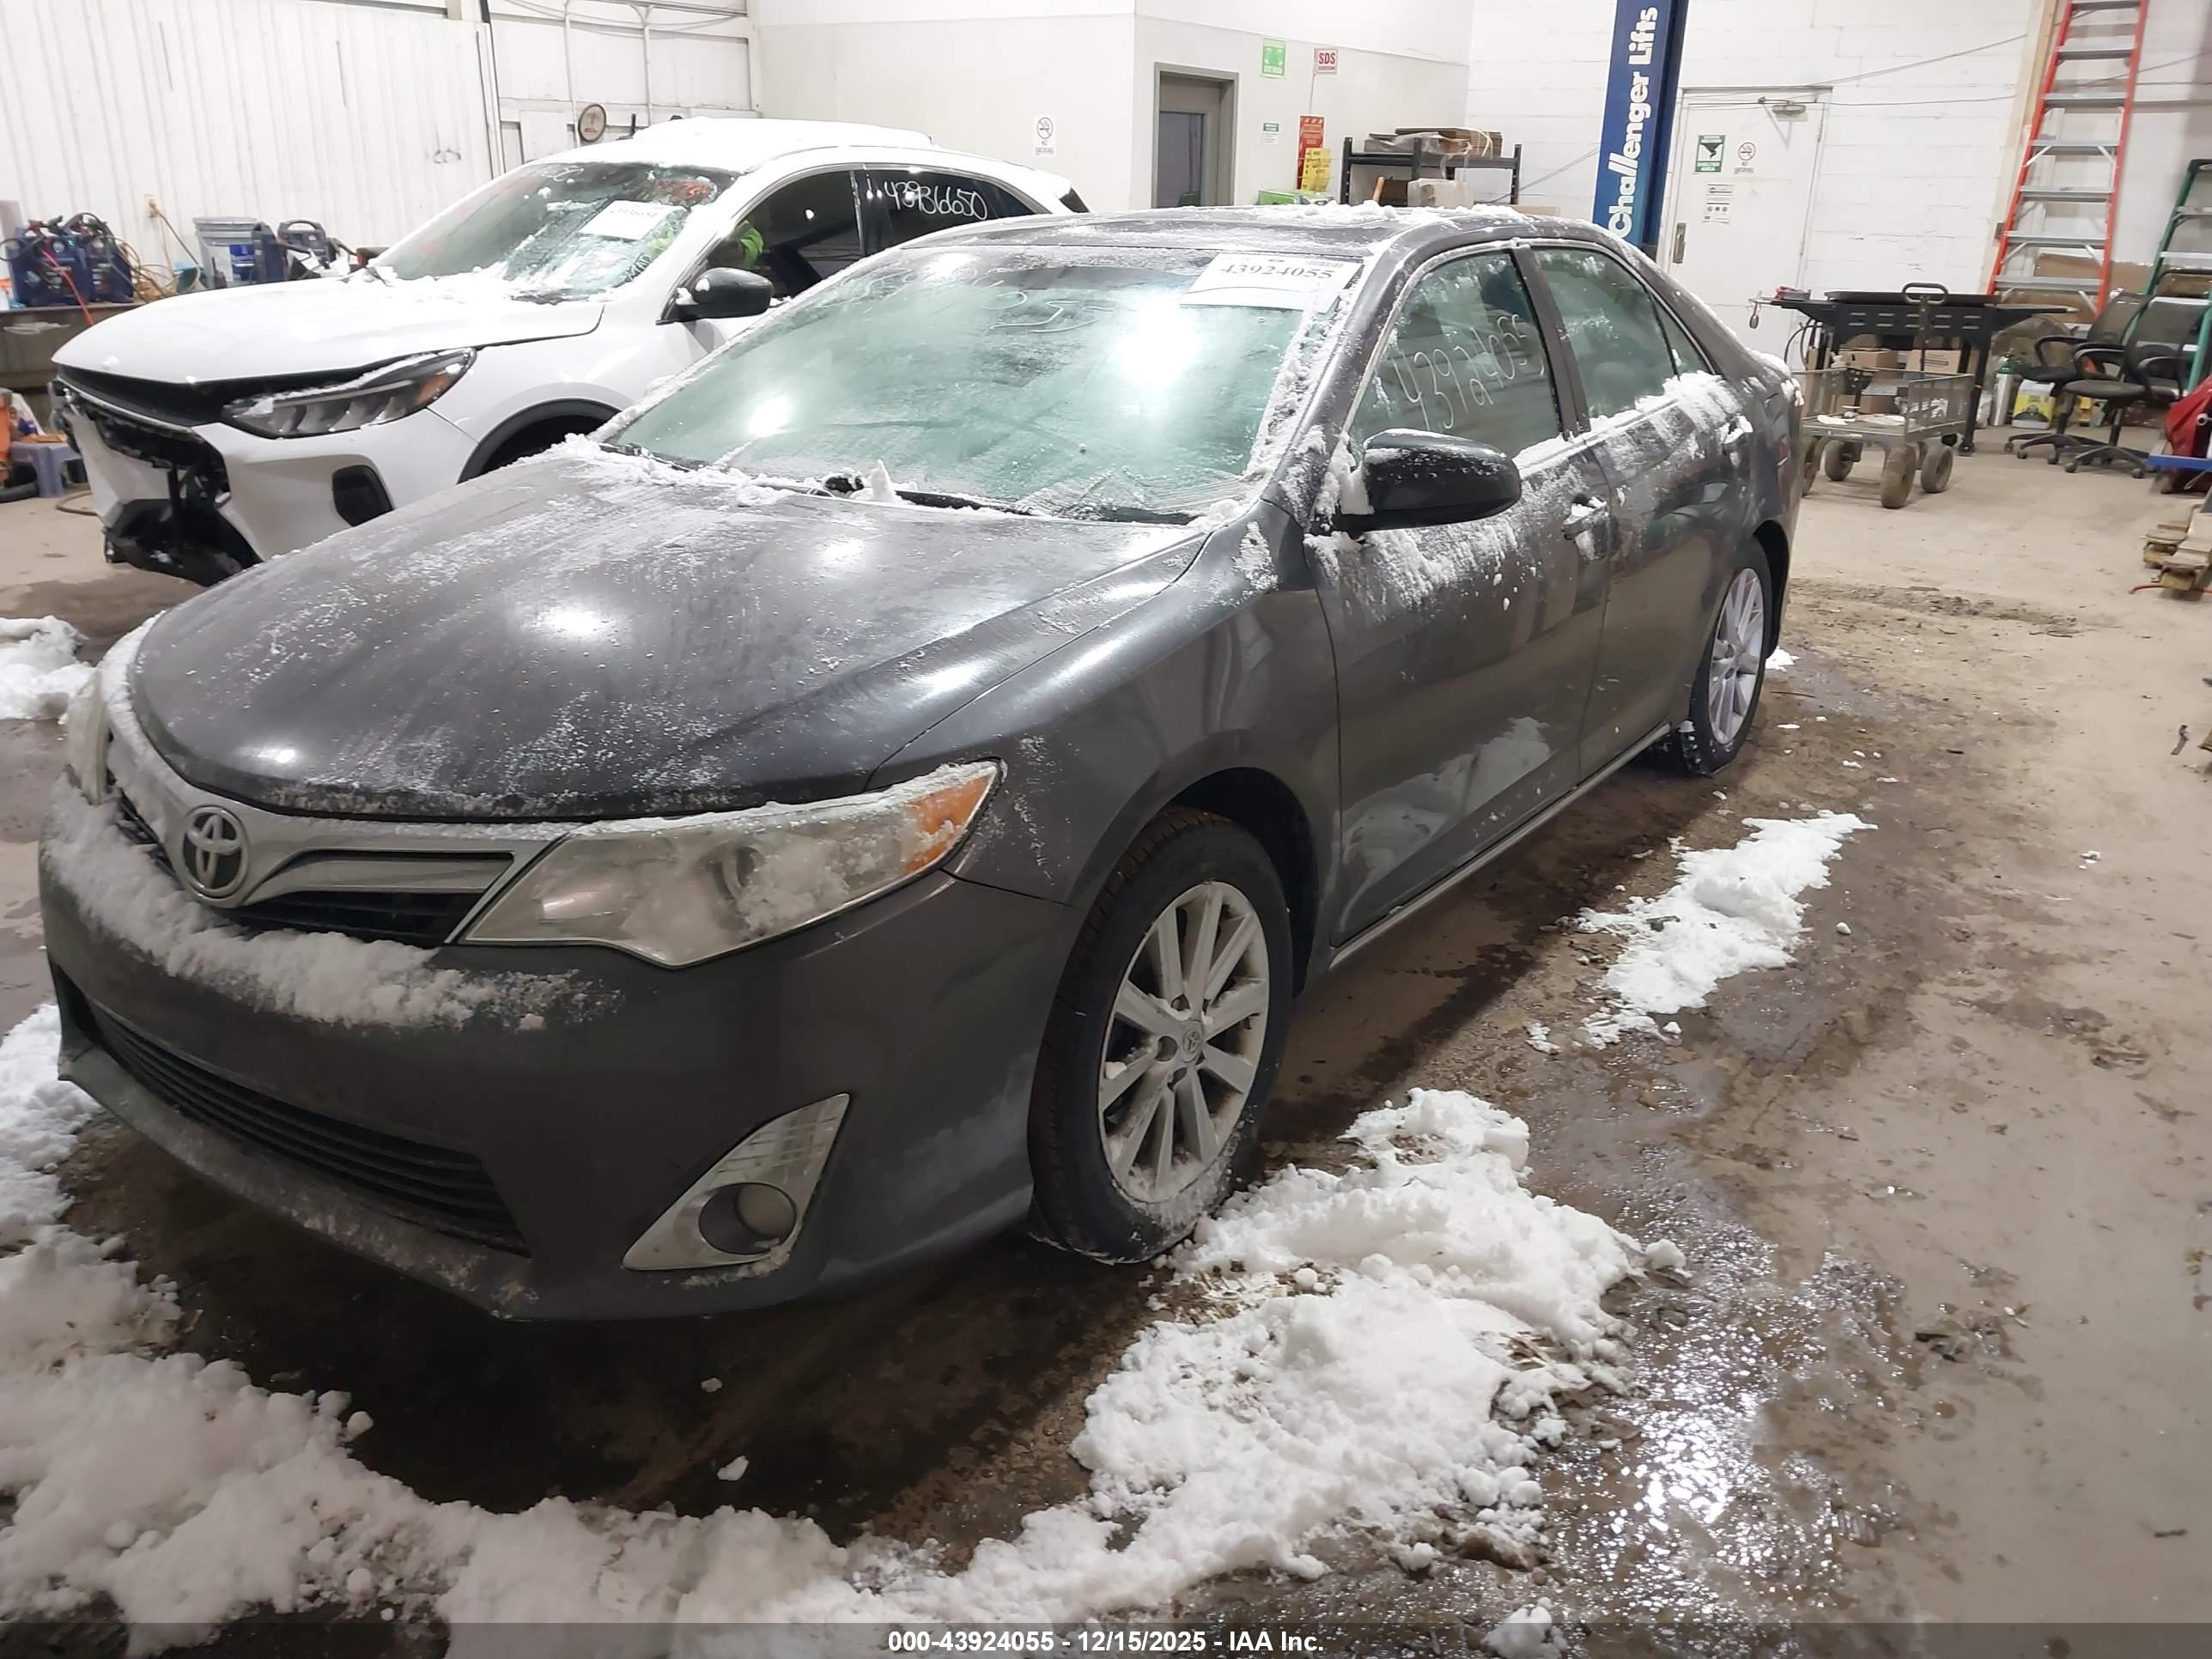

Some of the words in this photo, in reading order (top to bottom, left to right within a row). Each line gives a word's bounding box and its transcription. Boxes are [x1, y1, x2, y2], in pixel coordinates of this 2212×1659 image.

[1628, 6, 1658, 65] Lifts
[1318, 52, 1336, 64] SDS
[1608, 70, 1652, 240] Challenger
[1219, 263, 1335, 279] 43924055
